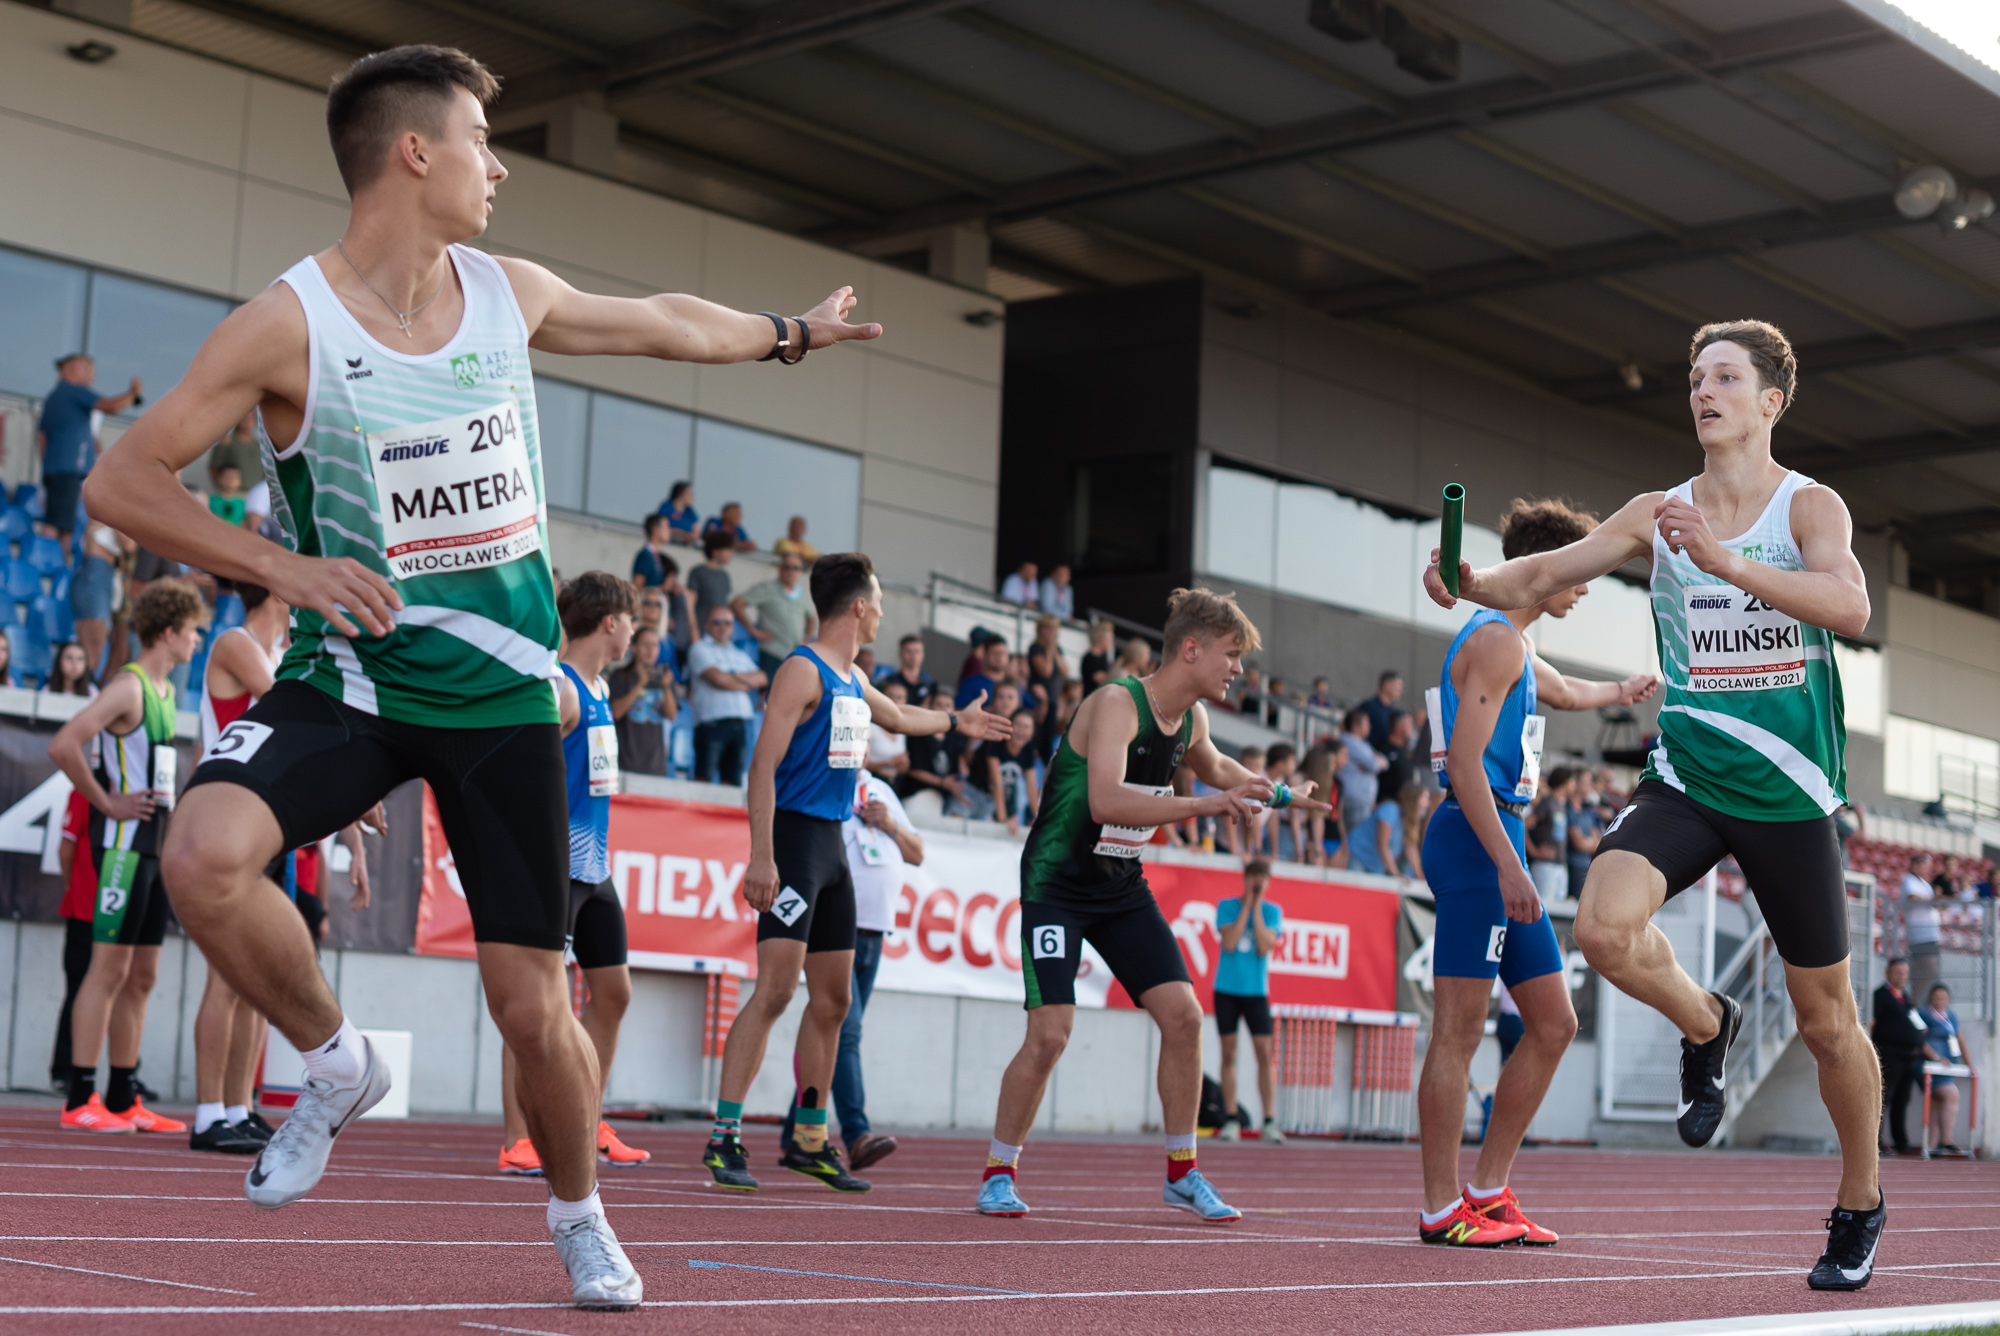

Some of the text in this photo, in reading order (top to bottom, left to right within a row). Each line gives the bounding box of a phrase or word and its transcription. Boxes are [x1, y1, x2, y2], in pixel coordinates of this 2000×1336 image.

[467, 409, 516, 452] 204
[380, 438, 450, 463] 4MOVE
[391, 467, 527, 523] MATERA
[399, 533, 535, 573] WŁOCŁAWEK 2021
[410, 541, 436, 551] PZLA
[437, 529, 503, 547] MISTRZOSTWA
[1689, 598, 1732, 610] 4MOVE
[1691, 623, 1800, 653] WILIŃSKI
[1693, 672, 1800, 690] WŁOCŁAWEK 2021
[1717, 666, 1765, 674] MISTRZOSTWA
[1765, 664, 1789, 672] POLSKI
[210, 725, 256, 755] 5
[106, 891, 120, 914] 2
[778, 898, 800, 918] 4
[1040, 928, 1059, 955] 6
[1273, 929, 1340, 967] RLEN
[1494, 930, 1505, 958] 8
